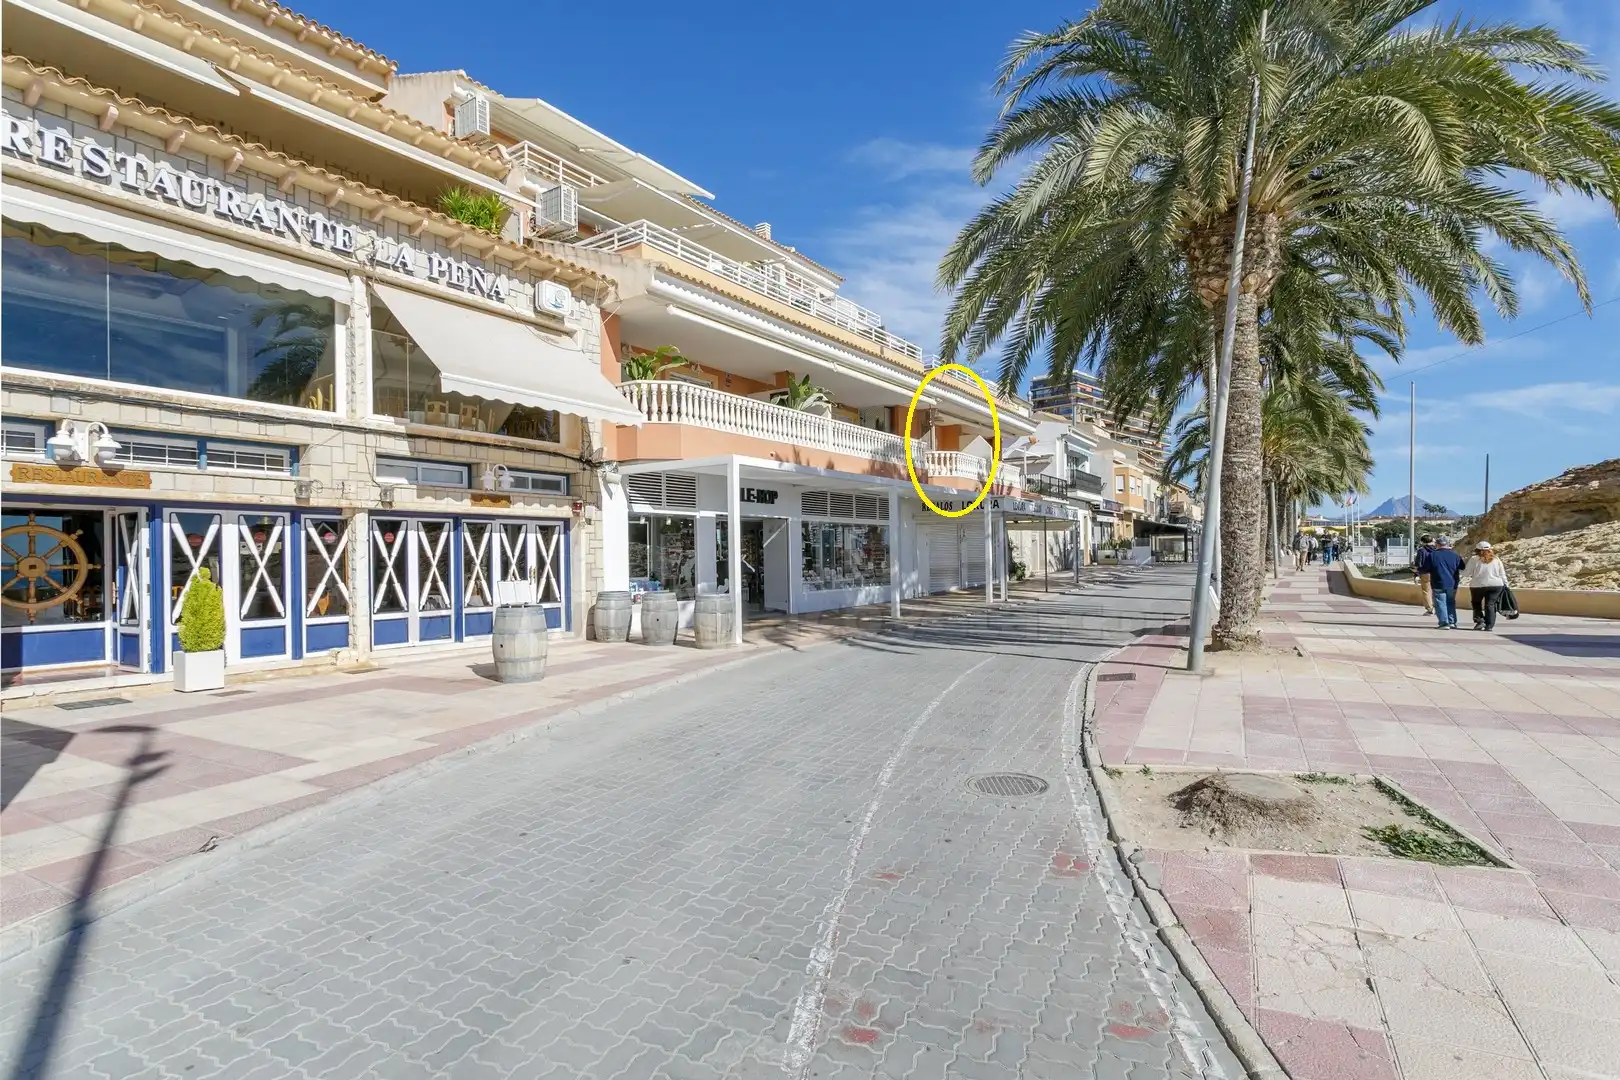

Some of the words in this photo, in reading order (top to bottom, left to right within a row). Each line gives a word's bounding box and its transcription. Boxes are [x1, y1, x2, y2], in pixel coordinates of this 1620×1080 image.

[2, 114, 357, 253] RESTAURANTE
[373, 239, 415, 272] LA
[428, 255, 506, 299] PEÑA
[17, 466, 146, 487] RESTAURANTE
[921, 501, 953, 511] RALOS
